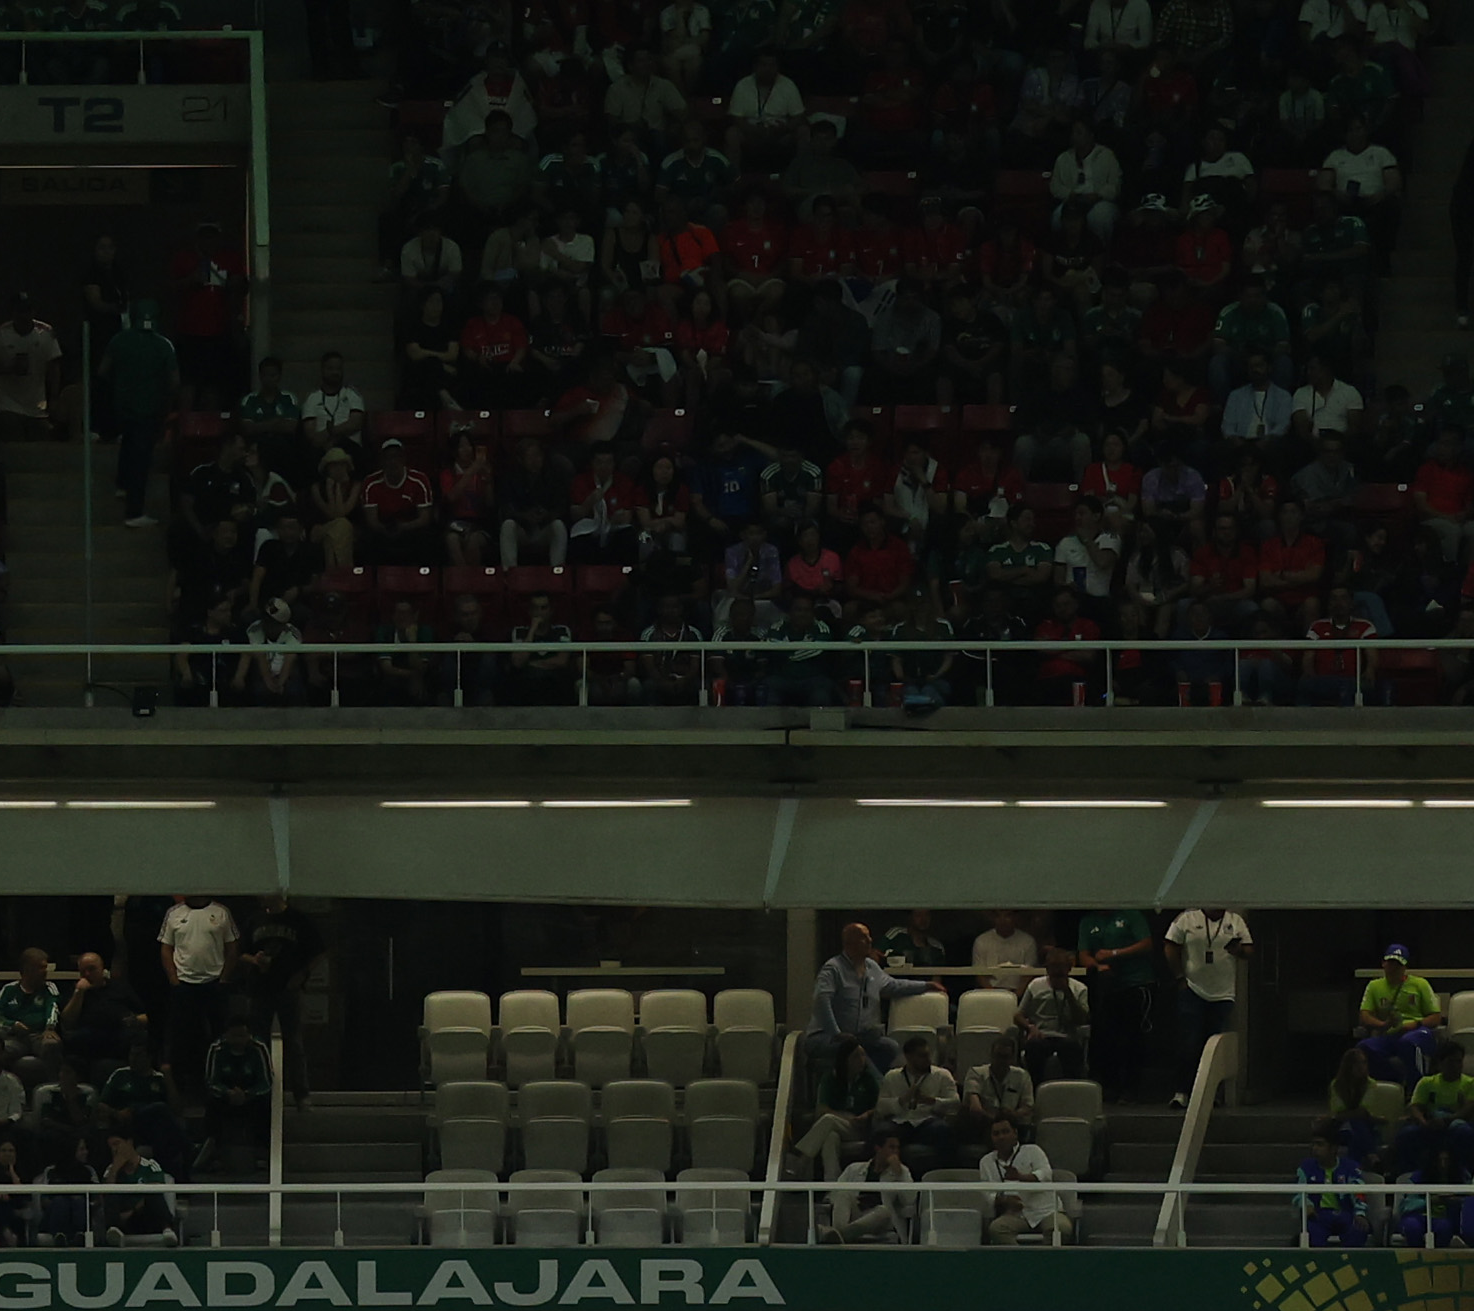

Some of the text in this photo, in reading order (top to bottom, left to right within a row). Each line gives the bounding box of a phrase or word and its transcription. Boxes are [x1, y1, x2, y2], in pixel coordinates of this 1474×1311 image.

[37, 96, 125, 133] T2
[181, 96, 229, 123] 21
[22, 177, 128, 194] SALIDA
